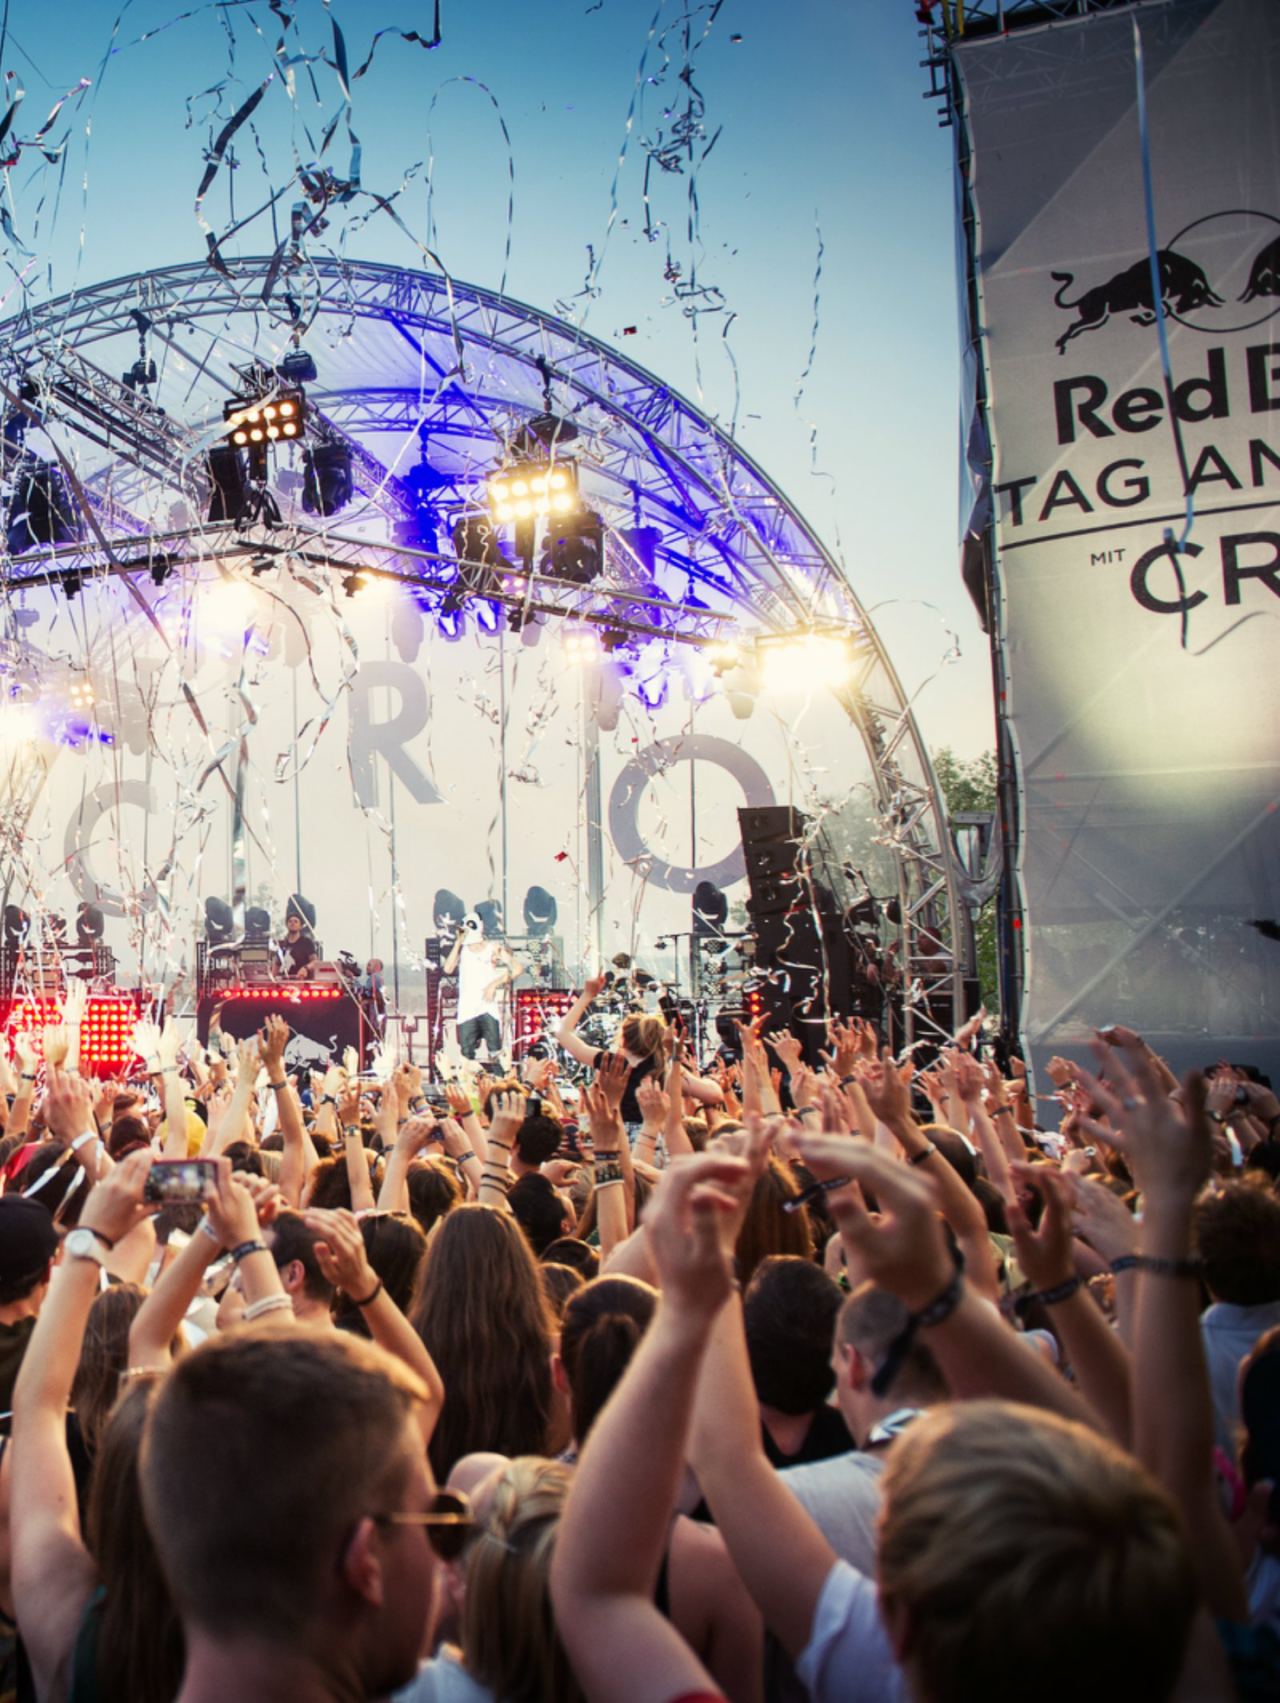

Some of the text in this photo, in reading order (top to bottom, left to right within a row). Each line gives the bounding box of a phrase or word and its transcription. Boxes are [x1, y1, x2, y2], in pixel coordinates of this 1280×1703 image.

[1053, 346, 1230, 445] Red
[993, 458, 1151, 527] TAG
[1090, 531, 1280, 614] MIT CR
